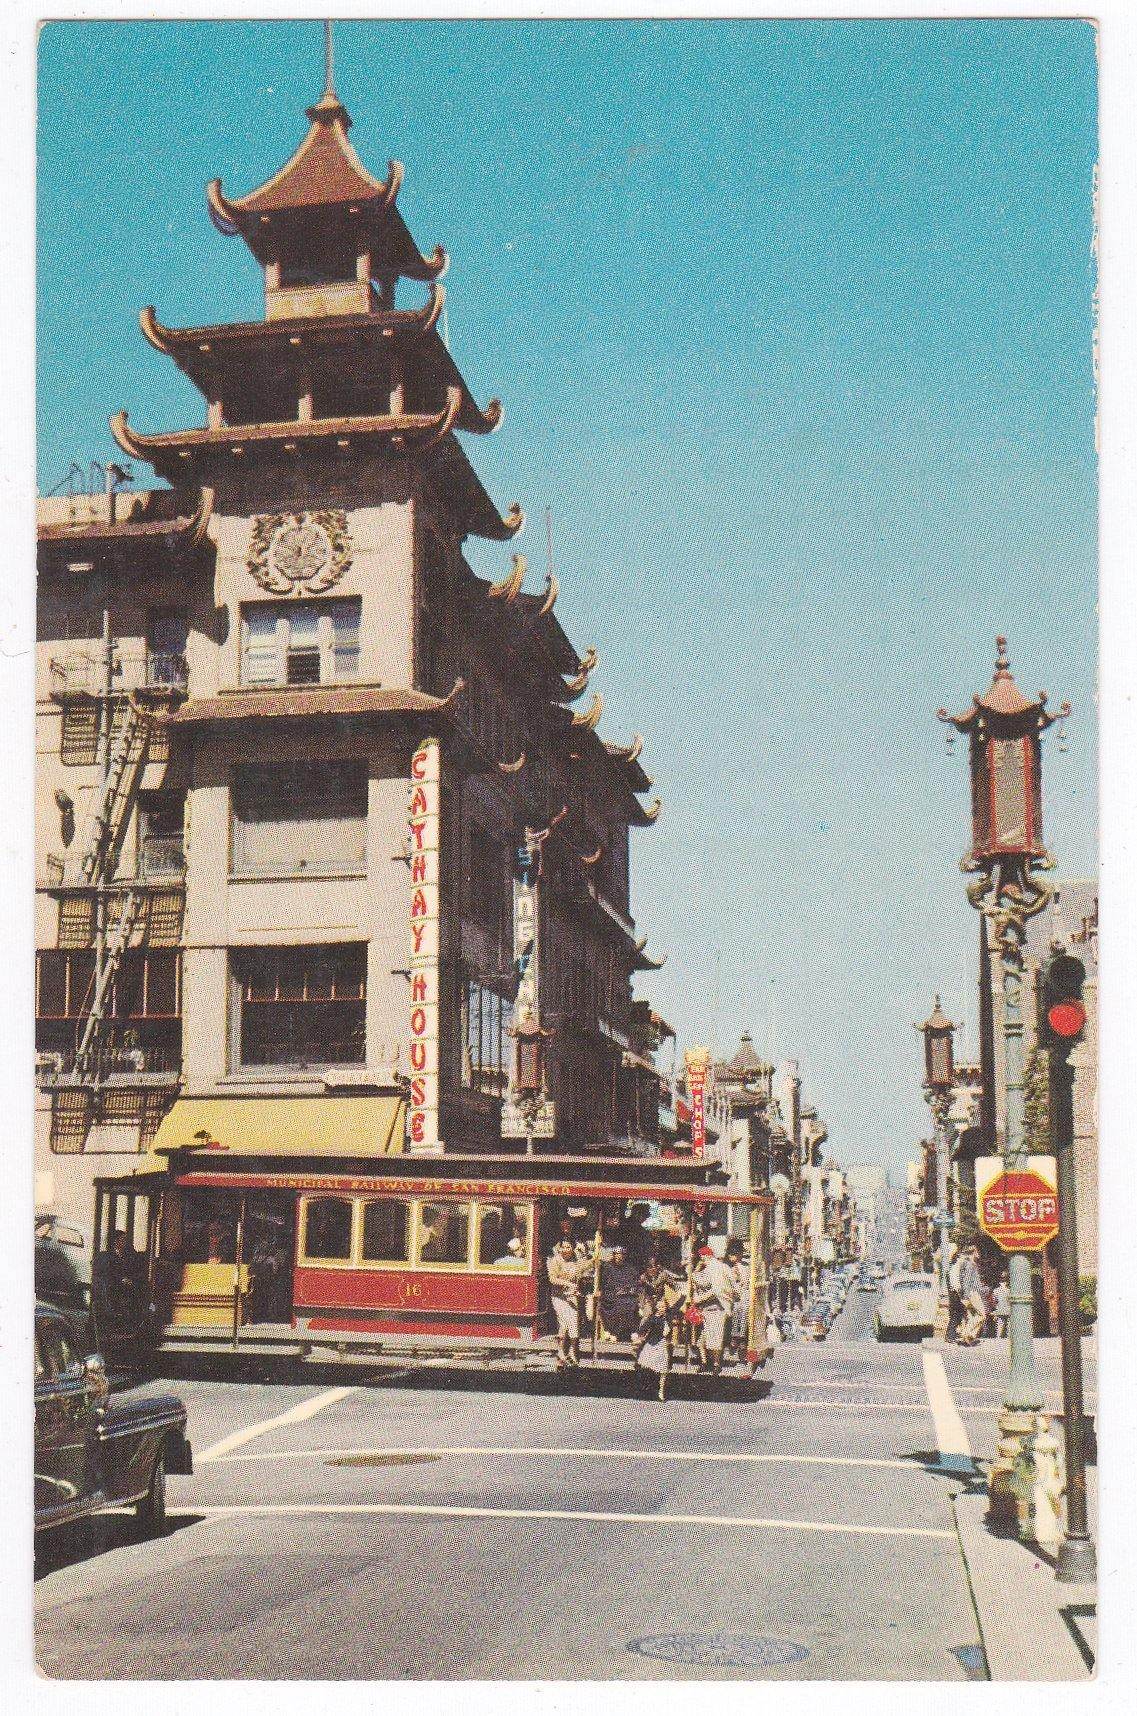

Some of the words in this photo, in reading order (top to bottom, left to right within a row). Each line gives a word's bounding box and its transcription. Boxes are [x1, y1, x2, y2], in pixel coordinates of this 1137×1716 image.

[410, 752, 427, 954] CATHAY
[410, 973, 427, 1143] HOUSE
[266, 1179, 341, 1189] MUNICIPAL
[351, 1180, 414, 1190] RAILWAY
[452, 1182, 478, 1192] SAN
[487, 1183, 569, 1194] FRANCISCO
[985, 1199, 1056, 1222] STOP
[405, 1283, 421, 1297] 16
